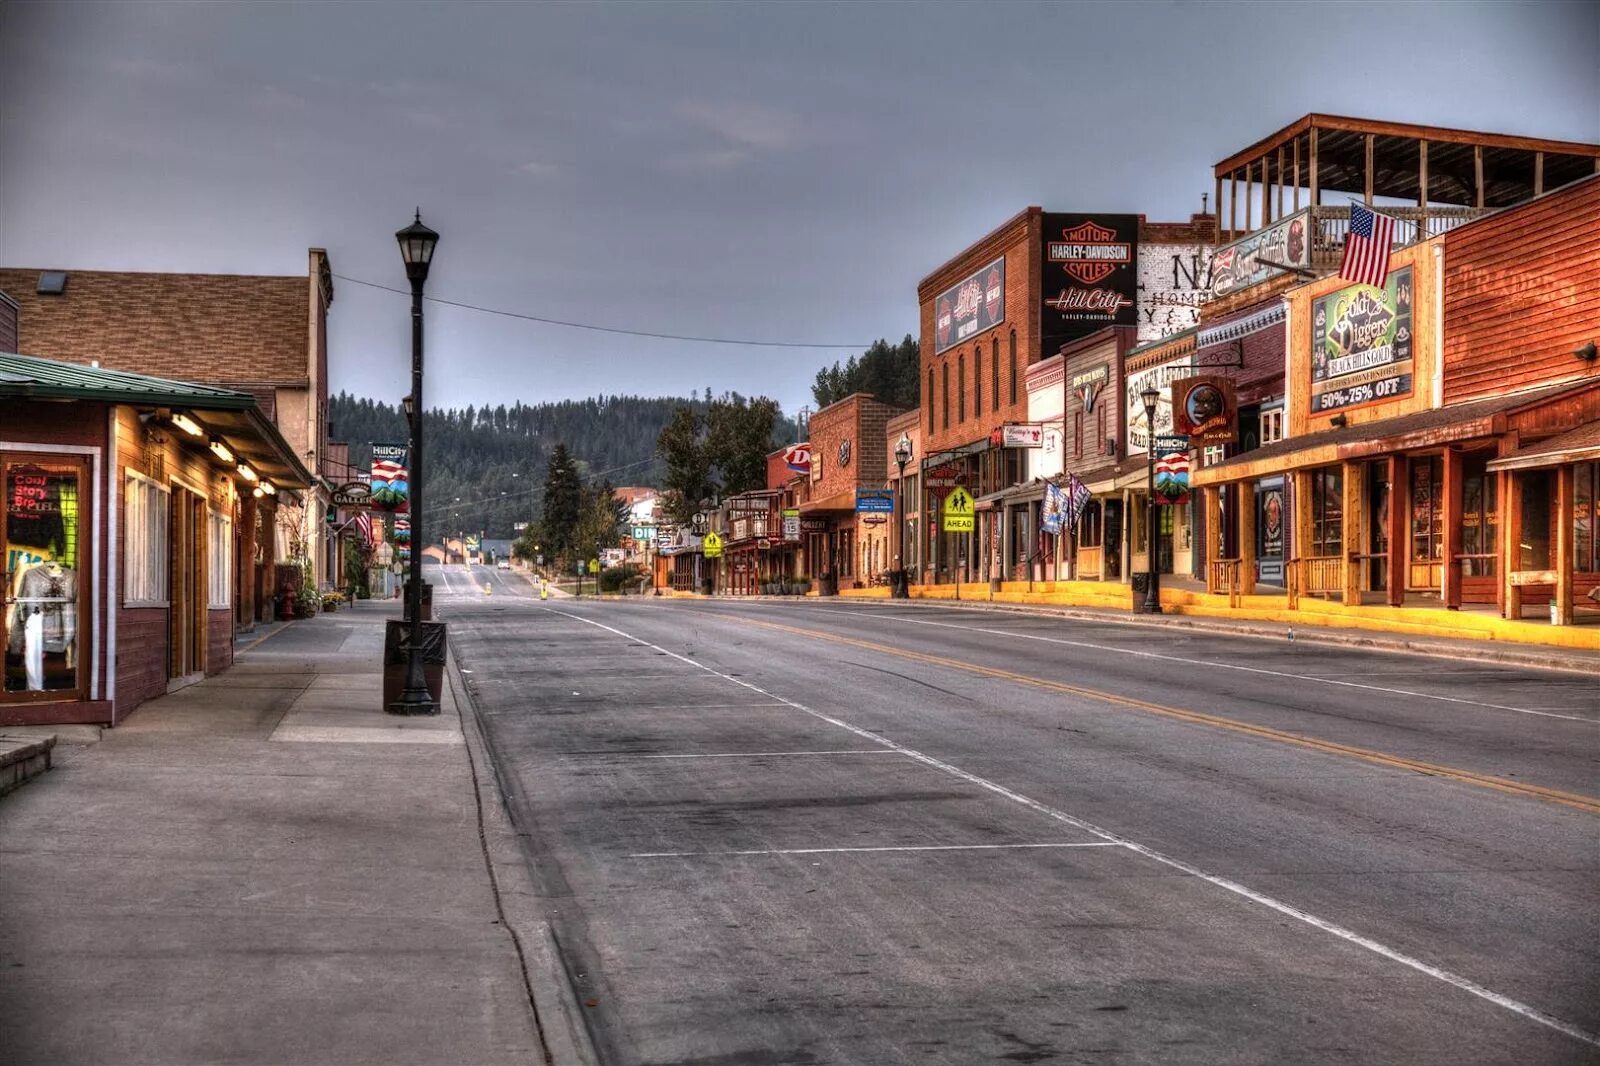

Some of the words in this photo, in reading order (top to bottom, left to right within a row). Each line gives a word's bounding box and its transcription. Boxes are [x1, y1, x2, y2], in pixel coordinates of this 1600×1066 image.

[1069, 226, 1110, 241] MOTOR
[1051, 245, 1127, 260] HARLEY-DAVIDSON
[1069, 262, 1110, 280] CYCLES
[1335, 290, 1370, 333] Gold
[1341, 319, 1388, 356] Diggers
[1330, 355, 1353, 375] BLACK
[1352, 350, 1372, 369] HILLS
[1371, 345, 1391, 364] GOLD
[1321, 384, 1373, 408] 50%-75%
[1375, 377, 1400, 397] OFF
